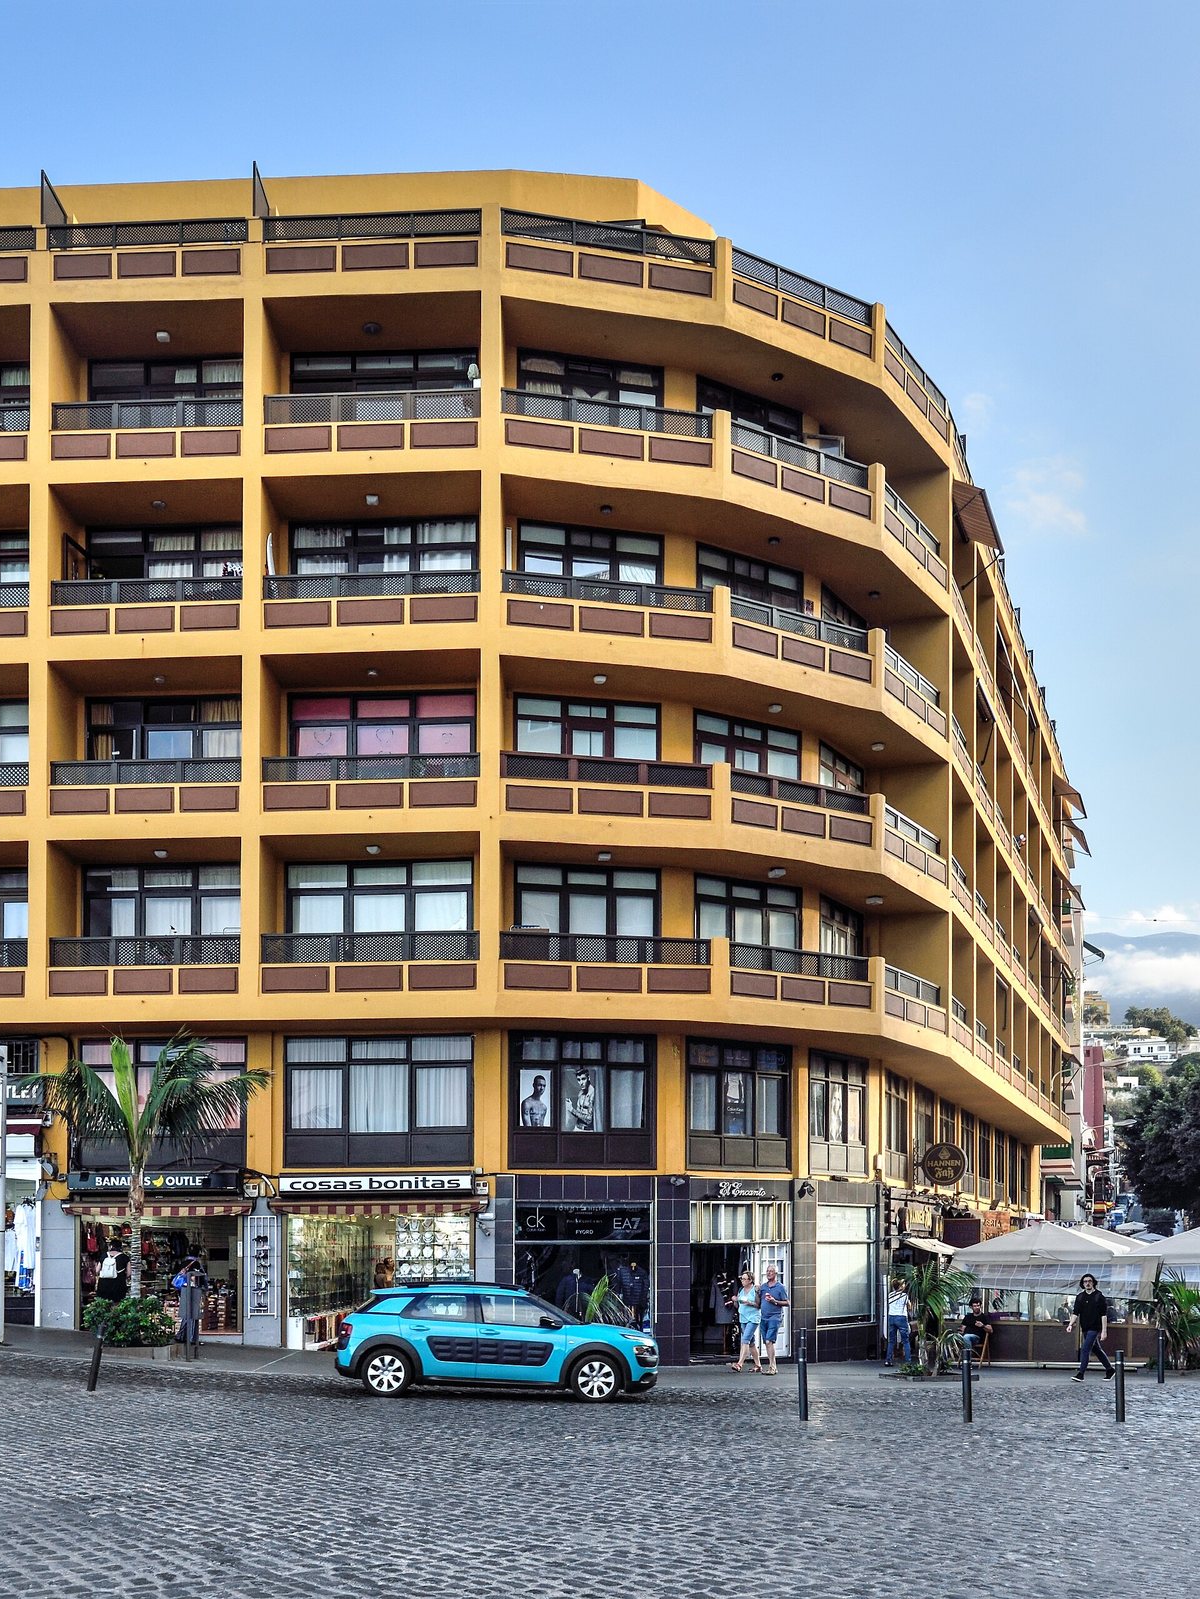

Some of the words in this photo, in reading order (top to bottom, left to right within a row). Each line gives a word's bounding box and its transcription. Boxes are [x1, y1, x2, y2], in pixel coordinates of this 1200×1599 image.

[96, 1176, 150, 1186] BANAS
[290, 1178, 363, 1191] cosas
[368, 1175, 462, 1190] bonitas
[719, 1182, 731, 1196] El
[731, 1182, 766, 1198] Encanto
[613, 1218, 640, 1230] EA7
